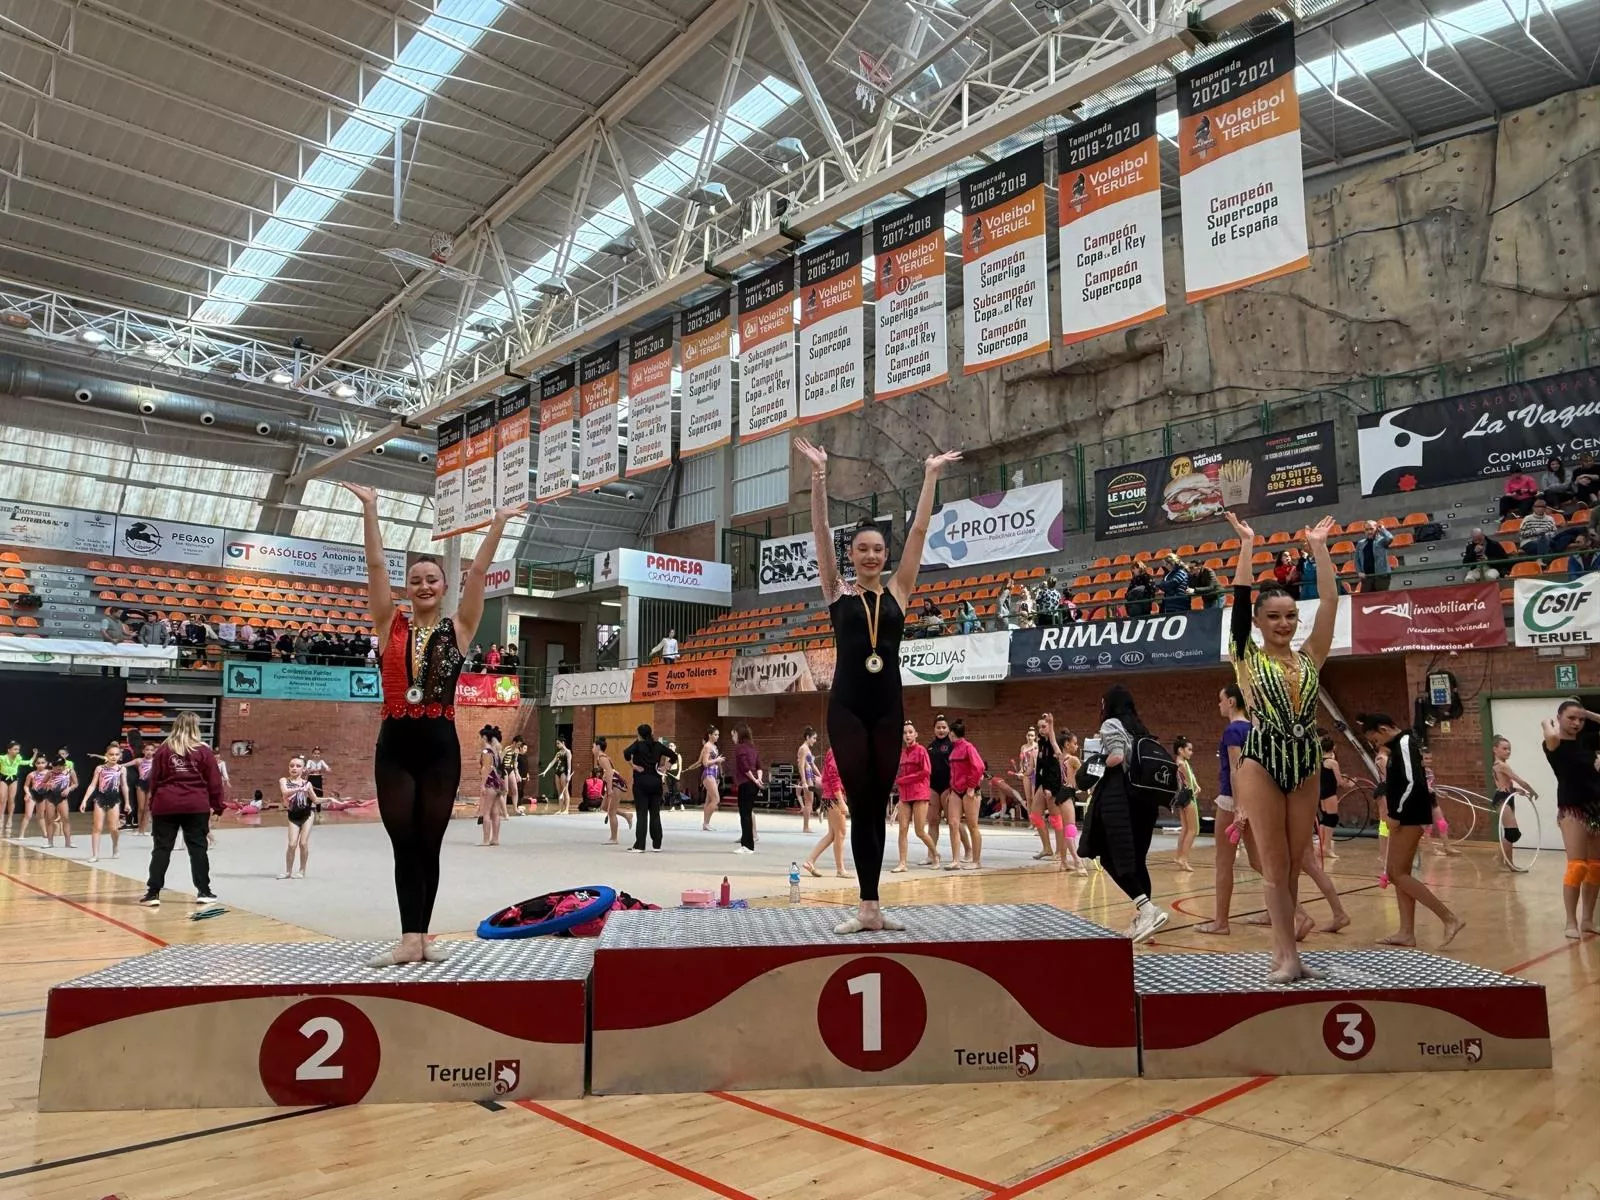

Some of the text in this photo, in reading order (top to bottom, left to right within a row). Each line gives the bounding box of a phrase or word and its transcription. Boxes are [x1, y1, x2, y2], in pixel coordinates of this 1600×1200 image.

[1190, 60, 1241, 88] Temporada
[1192, 58, 1275, 108] 2020-2021
[1215, 90, 1285, 129] Voleibol
[1068, 123, 1112, 147] Temporada
[1222, 110, 1280, 142] TERUEL
[1070, 122, 1140, 165] 2019-2020
[1090, 152, 1148, 185] Voleibol
[970, 171, 1006, 193] Temporada
[971, 172, 1027, 209] 2018-2019
[1095, 174, 1144, 197] TERUEL
[1210, 180, 1273, 214] Campeón
[882, 212, 913, 232] Temporada
[985, 199, 1035, 229] Voleibol
[1208, 195, 1279, 230] Supercopa
[883, 216, 931, 247] 2017-2018
[990, 217, 1031, 240] TERUEL
[1084, 223, 1136, 251] Campeón
[1212, 214, 1278, 247] de España
[807, 250, 835, 266] Temporada
[896, 238, 938, 265] Voleibol
[1077, 234, 1146, 268] Copa el Rey
[808, 252, 849, 281] 2016-2017
[900, 254, 935, 274] TERUEL
[980, 251, 1025, 276] Campeón
[1085, 260, 1138, 287] Campeón
[818, 275, 856, 300] Voleibol
[980, 263, 1026, 289] Superliga
[1082, 273, 1142, 302] Supercopa
[745, 281, 784, 308] 2014-2015
[822, 290, 853, 309] TERUEL
[890, 290, 929, 313] Campeón
[973, 280, 1036, 310] Subcampeón
[688, 308, 721, 332] 2013-2014
[759, 302, 791, 326] Voleibol
[880, 305, 919, 328] Superliga
[974, 294, 1033, 323] Copa el Rey
[699, 328, 727, 347] Voleibol
[760, 319, 784, 333] TERUEL
[812, 325, 848, 346] Campeón
[890, 321, 929, 343] Campeón
[981, 318, 1026, 342] Campeón
[699, 343, 721, 356] TERUEL
[748, 340, 787, 364] Subcampeón
[809, 337, 851, 360] Supercopa
[885, 331, 936, 356] Copa el Rey
[978, 331, 1028, 356] Supercopa
[643, 358, 671, 375] Voleibol
[744, 357, 772, 376] Superliga
[891, 350, 929, 371] Campeón
[690, 364, 721, 384] Campeón
[752, 369, 783, 388] Campeón
[805, 361, 855, 386] Subcampeón
[887, 363, 931, 384] Supercopa
[689, 378, 721, 397] Superliga
[745, 388, 762, 403] Copa
[776, 378, 790, 392] Rey
[805, 376, 856, 400] Copa el Rey
[588, 396, 611, 410] Teruel
[632, 405, 654, 419] Superliga
[752, 398, 783, 417] Campeón
[688, 419, 722, 438] Supercopa
[691, 409, 719, 426] Campeón
[750, 409, 787, 429] Supercopa
[1462, 401, 1600, 439] La Vaqu
[587, 425, 612, 440] Superliga
[631, 423, 667, 442] Copa Rey
[633, 451, 663, 466] Supercopa
[1488, 445, 1552, 464] COMIDAS
[1557, 444, 1565, 452] Y
[605, 461, 616, 472] Rey
[1271, 467, 1318, 482] 978 611 175
[1267, 474, 1322, 491] 696 738 559
[1108, 488, 1146, 502] LE TOUR
[172, 533, 215, 544] PEGASO
[227, 542, 255, 560] GT
[260, 546, 318, 560] GASÓLEOS
[323, 552, 356, 561] Antonio
[294, 560, 316, 568] TERUEL
[647, 555, 702, 575] PAMESA
[1414, 599, 1486, 616] inmobiliaria
[1537, 591, 1592, 614] CSIF
[1039, 615, 1187, 651] RIMAUTO
[1528, 631, 1592, 643] TERUEL
[1124, 653, 1141, 662] KIA
[735, 655, 797, 688] gregorio
[666, 680, 689, 690] Torres
[847, 973, 881, 1051] 1
[1336, 1014, 1364, 1054] 3
[295, 1016, 344, 1080] 2
[954, 1047, 1013, 1066] Teruel
[1418, 1041, 1463, 1055] Teruel
[427, 1062, 492, 1082] Teruel
